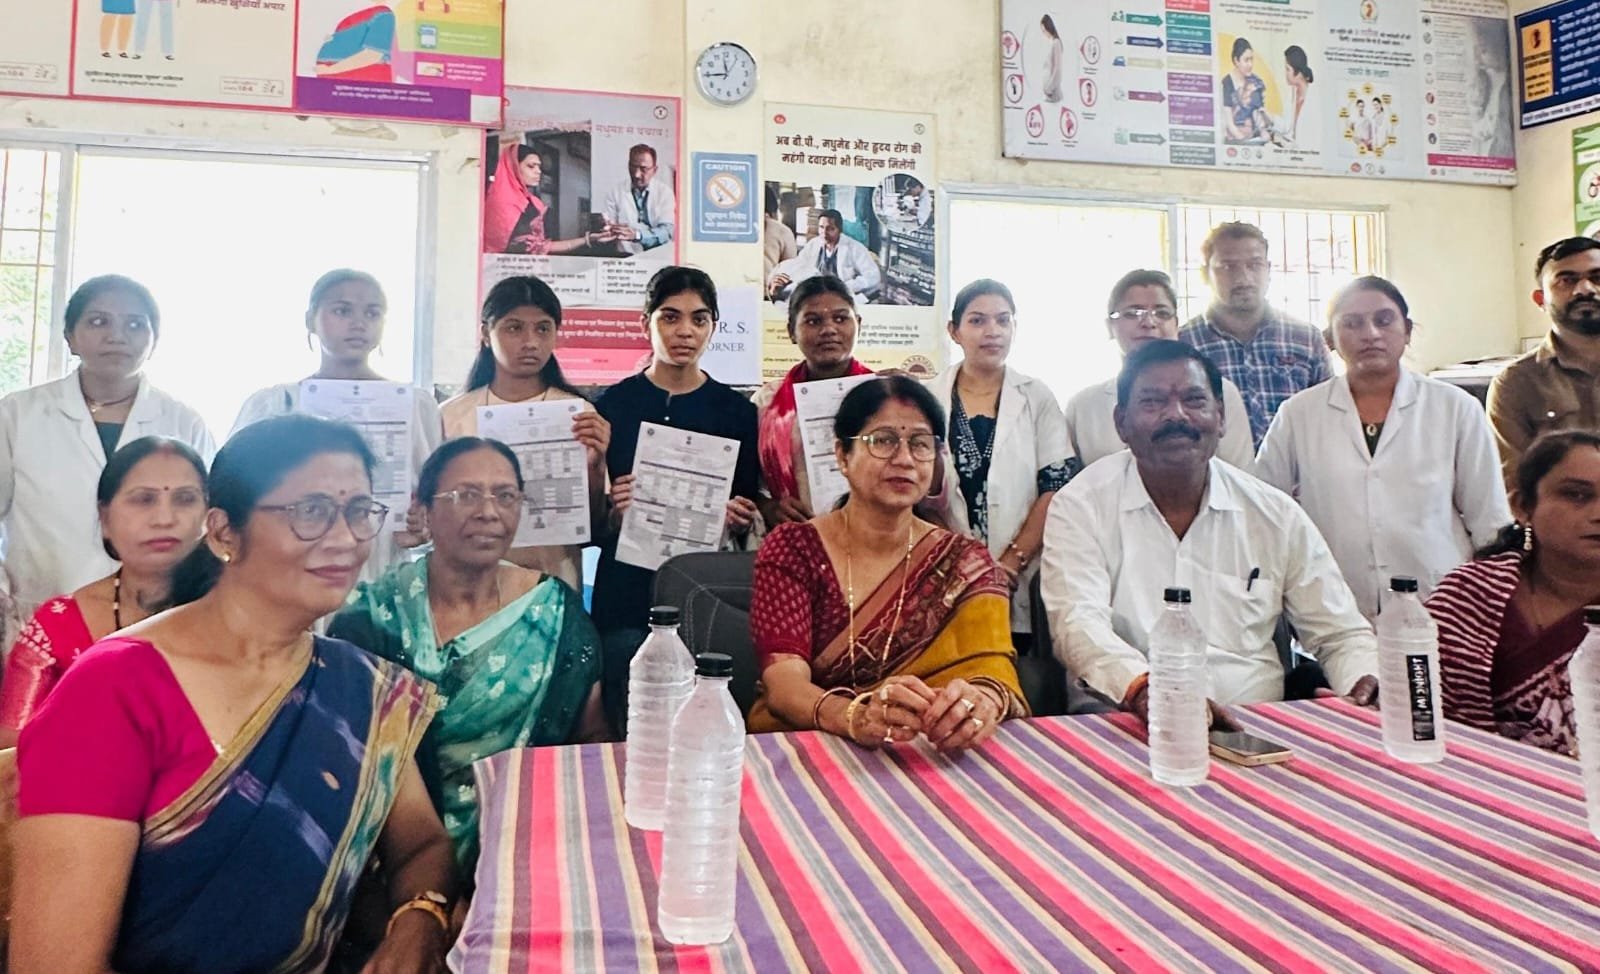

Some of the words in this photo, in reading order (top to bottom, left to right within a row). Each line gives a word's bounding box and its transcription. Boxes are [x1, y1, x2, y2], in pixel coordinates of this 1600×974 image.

[776, 136, 789, 145] अब
[821, 138, 850, 151] मधुमेह
[854, 138, 869, 151] और
[894, 141, 908, 153] रोग
[911, 142, 921, 154] की
[840, 154, 850, 166] भी
[705, 163, 746, 171] CAUTION
[737, 321, 750, 335] S.
